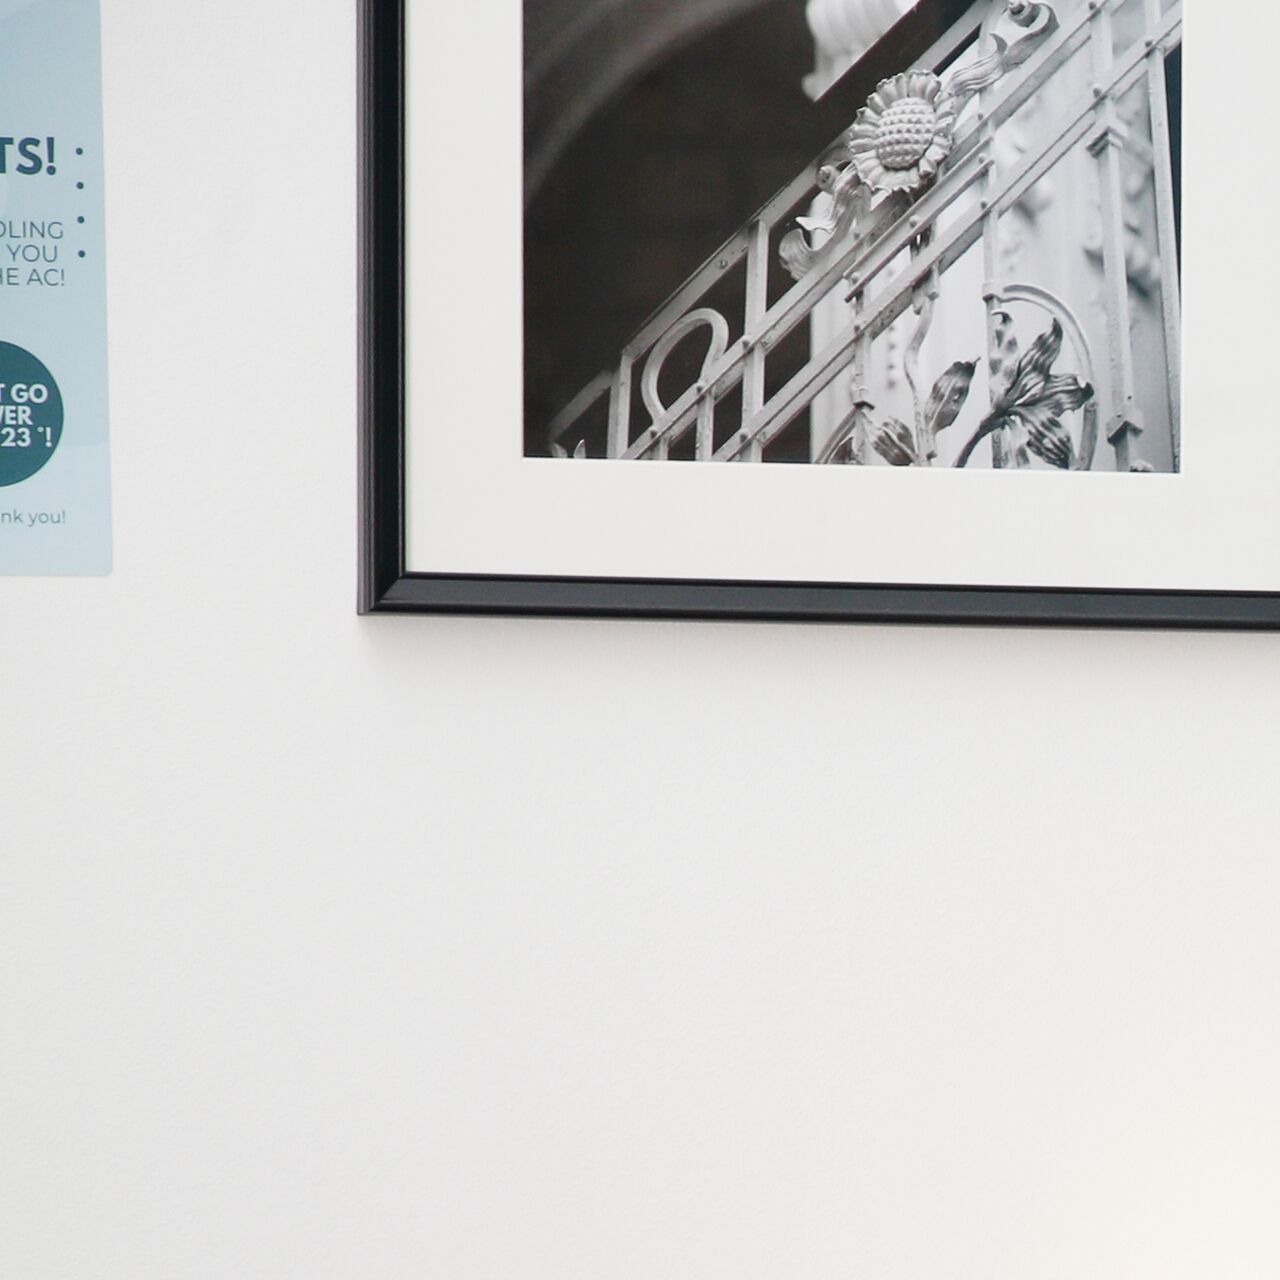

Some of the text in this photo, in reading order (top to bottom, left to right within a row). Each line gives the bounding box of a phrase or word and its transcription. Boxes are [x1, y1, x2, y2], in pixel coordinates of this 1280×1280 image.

[6, 244, 58, 263] YOU
[26, 268, 65, 287] AC!
[10, 383, 49, 404] GO
[0, 405, 34, 426] ER
[0, 427, 31, 448] 23
[28, 509, 66, 528] you!
